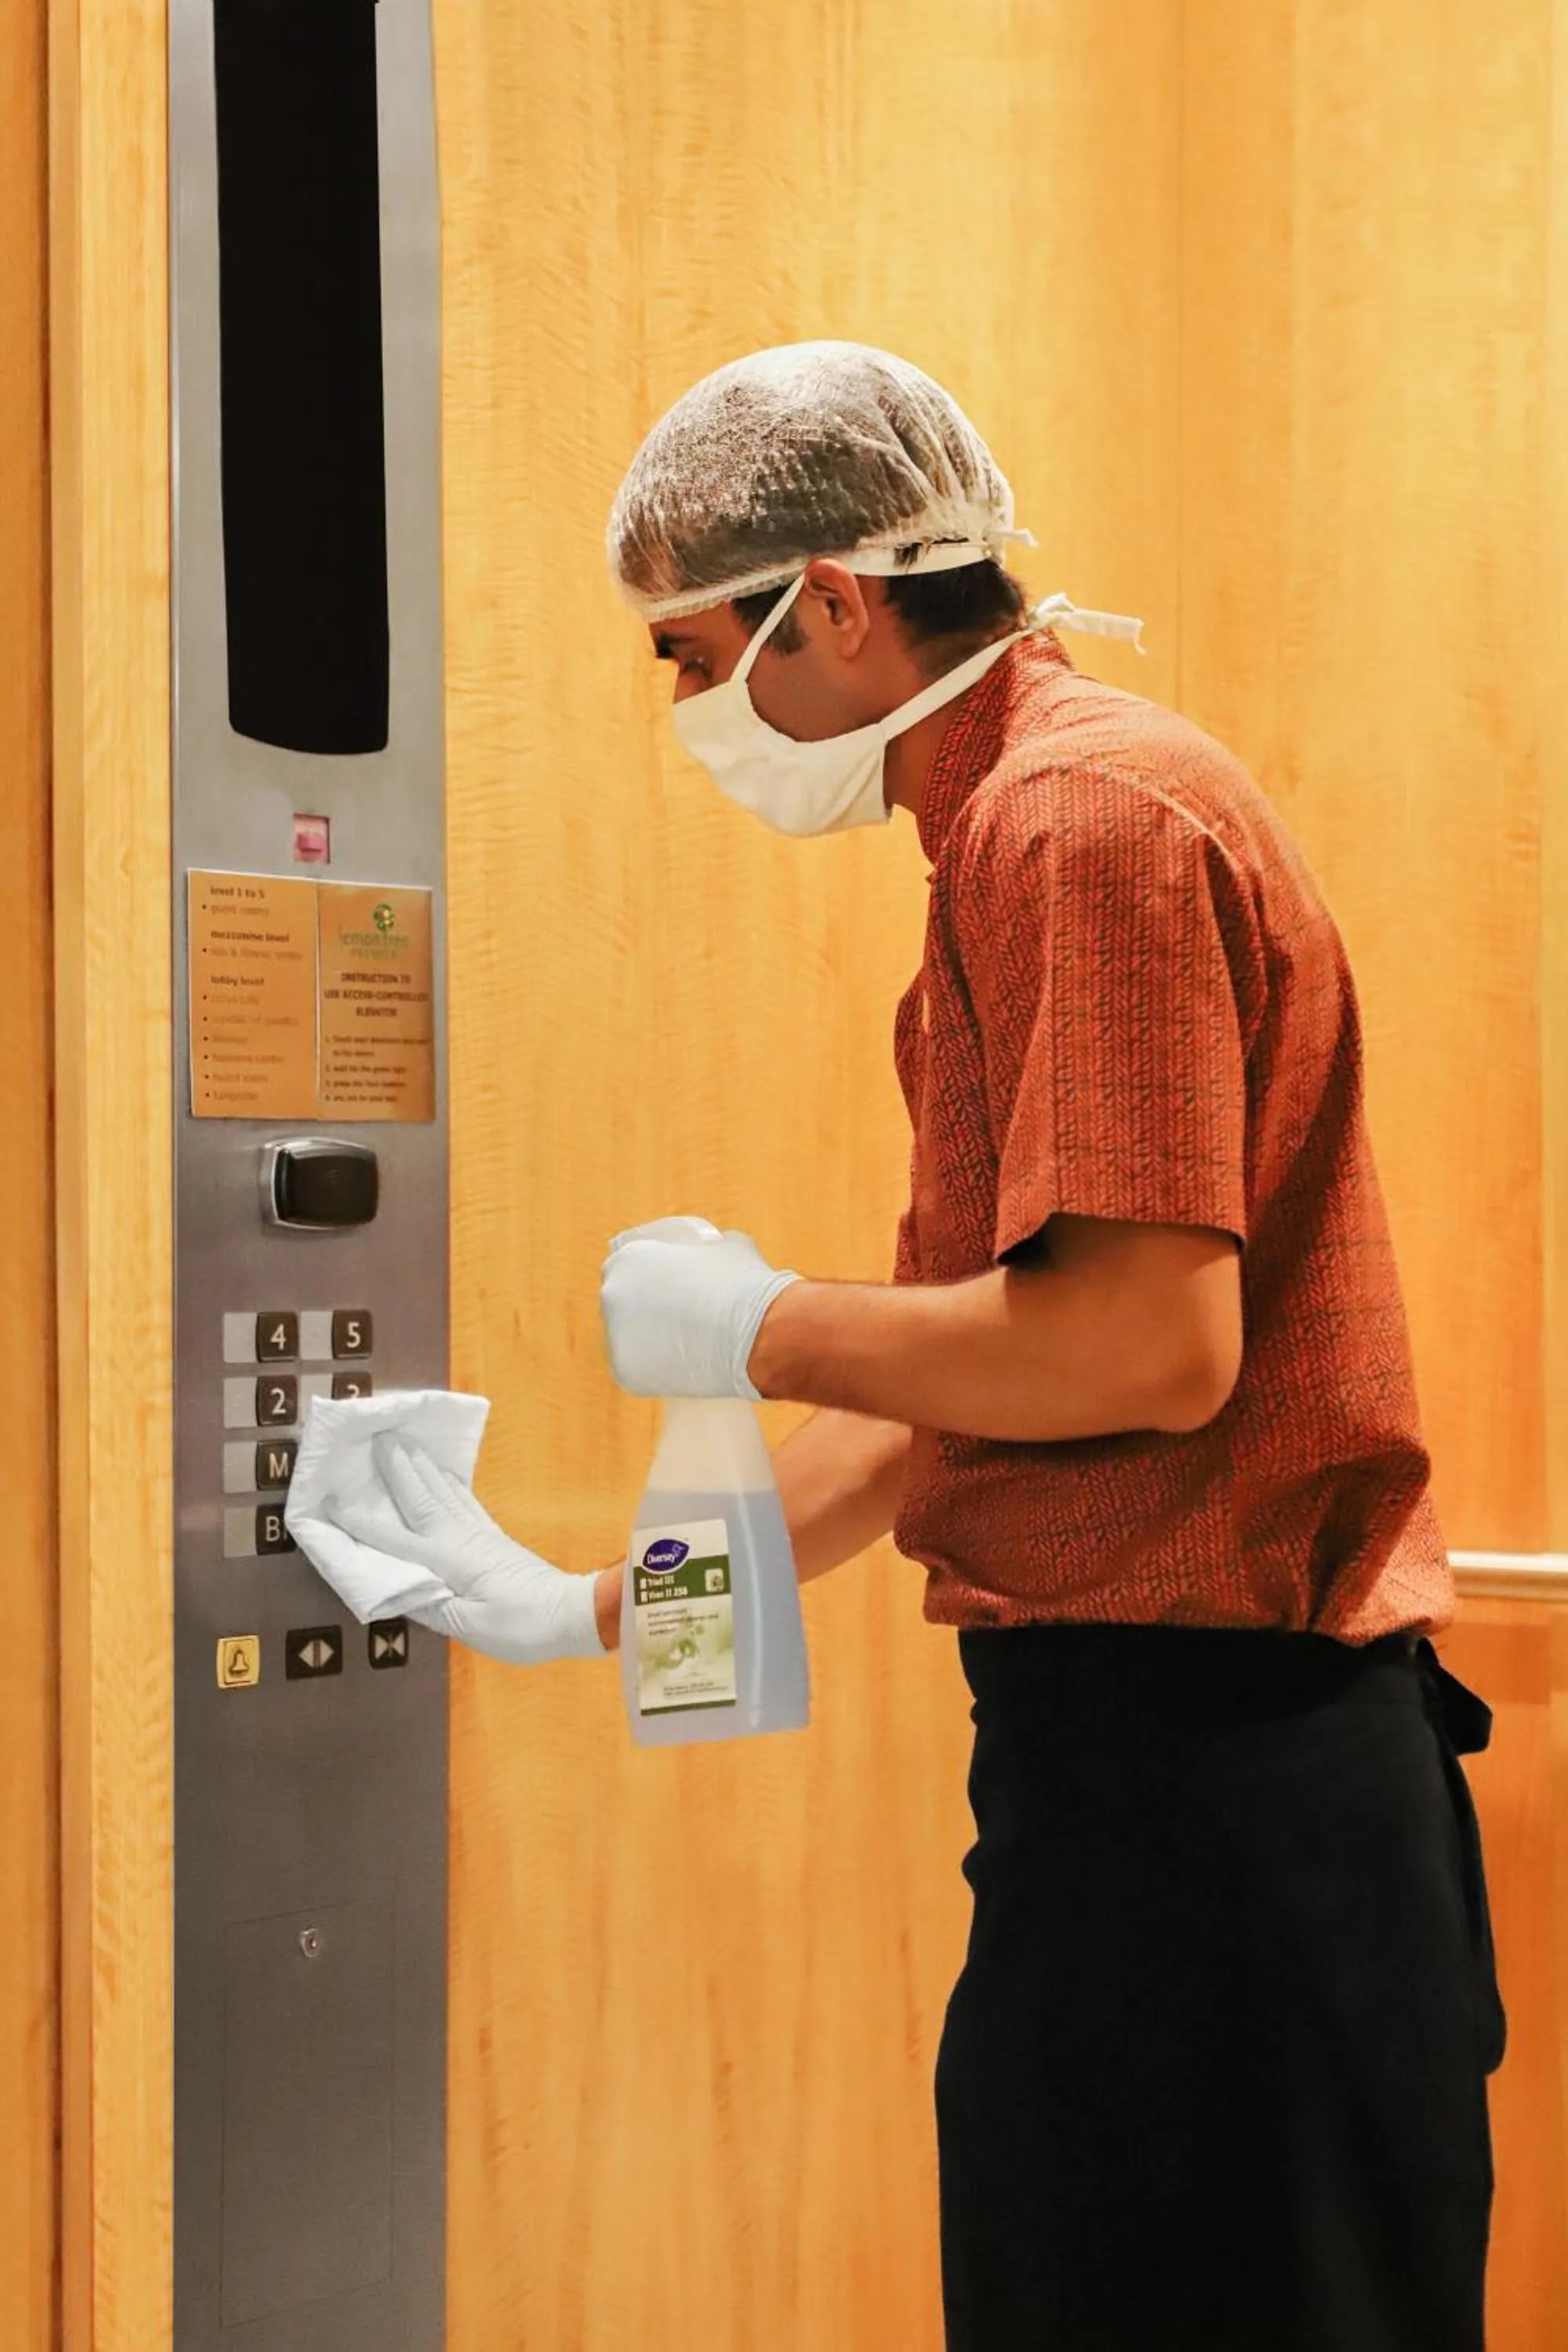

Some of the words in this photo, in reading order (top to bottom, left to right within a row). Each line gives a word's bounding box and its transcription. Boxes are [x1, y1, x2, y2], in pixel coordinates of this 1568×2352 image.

[270, 1323, 287, 1351] 4
[346, 1322, 361, 1348] 5
[270, 1388, 287, 1415] 2
[269, 1452, 289, 1479] M
